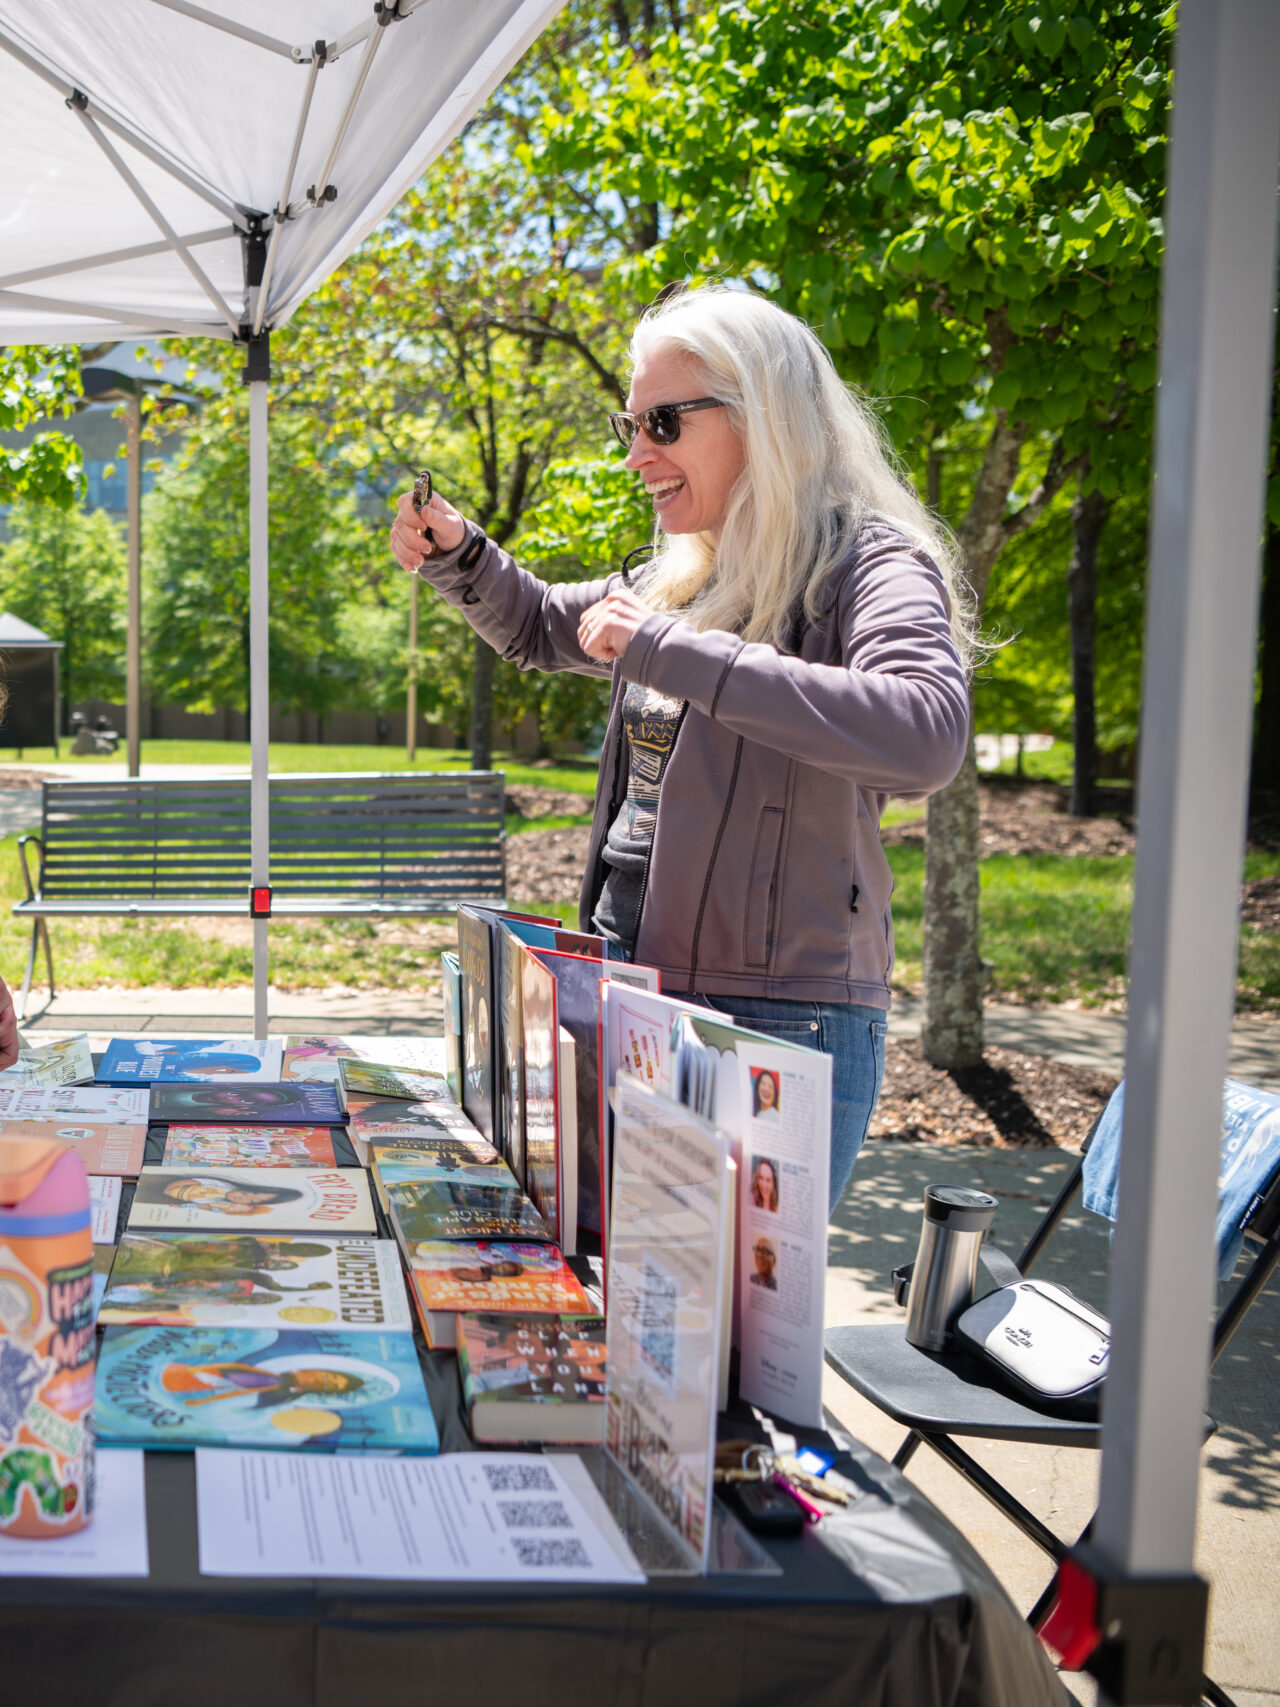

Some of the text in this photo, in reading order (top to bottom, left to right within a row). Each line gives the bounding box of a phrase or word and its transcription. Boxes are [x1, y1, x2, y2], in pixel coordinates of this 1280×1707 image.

[116, 1061, 138, 1073] BLUE
[138, 1056, 165, 1078] PROUDEST
[243, 1139, 265, 1151] DAY
[307, 1173, 358, 1221] FRY BREAD
[448, 1209, 492, 1217] CLUB
[437, 1216, 536, 1226] TELEGRAPH
[445, 1227, 502, 1235] NIGHT
[336, 1245, 384, 1324] UNDEFEATED
[518, 1330, 589, 1340] CLAP
[516, 1344, 601, 1358] WHEN
[536, 1364, 592, 1375] YOU
